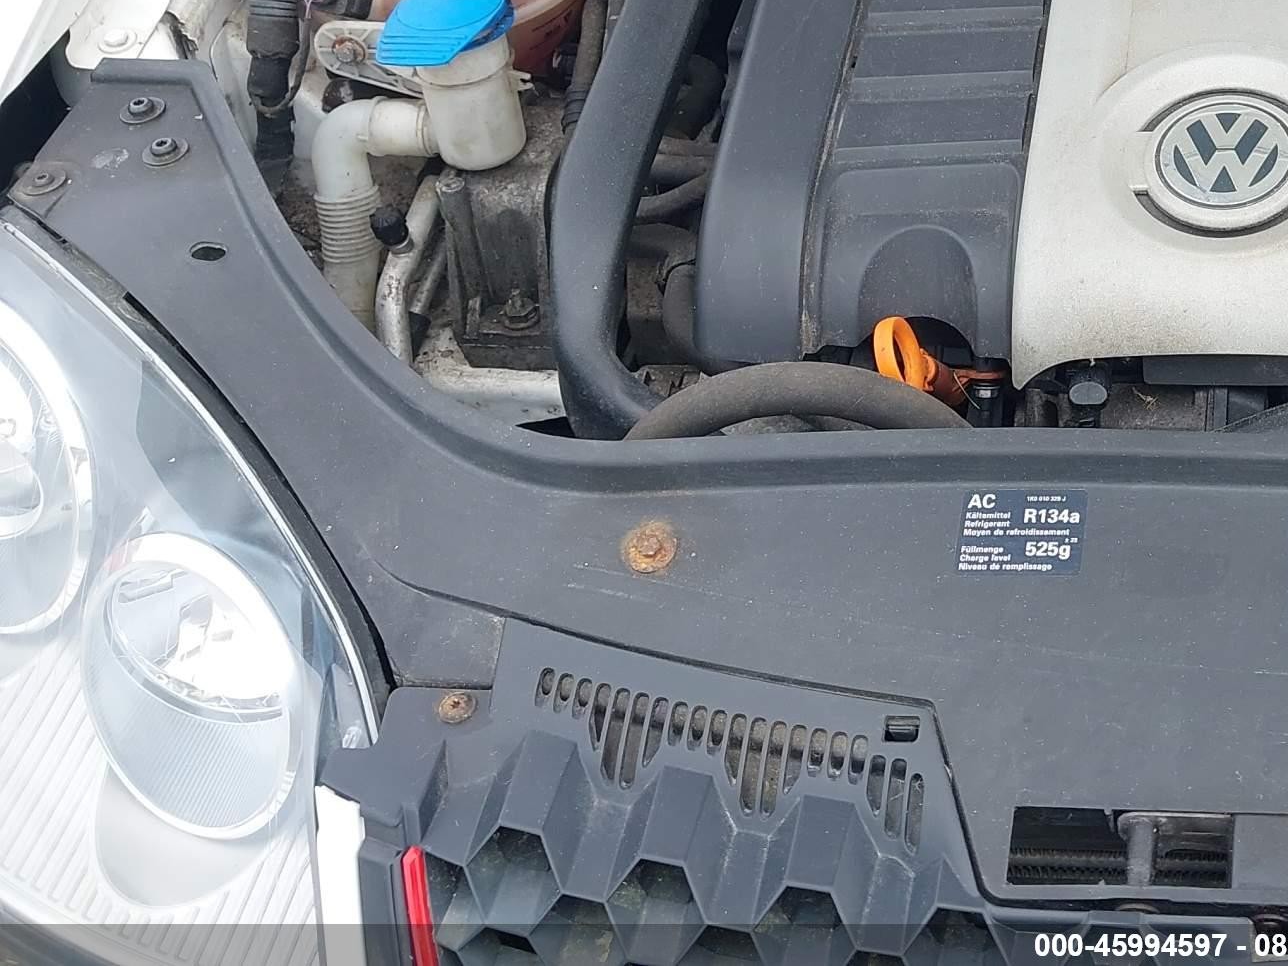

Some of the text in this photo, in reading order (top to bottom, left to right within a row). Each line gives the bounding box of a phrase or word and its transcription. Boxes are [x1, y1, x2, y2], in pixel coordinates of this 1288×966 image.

[968, 494, 996, 508] AC
[1024, 509, 1080, 523] R134a
[963, 529, 991, 537] Moyen
[961, 546, 1004, 554] Füllmenge
[1025, 542, 1071, 560] 525g
[960, 554, 988, 563] Charge
[1003, 563, 1052, 571] remplissage
